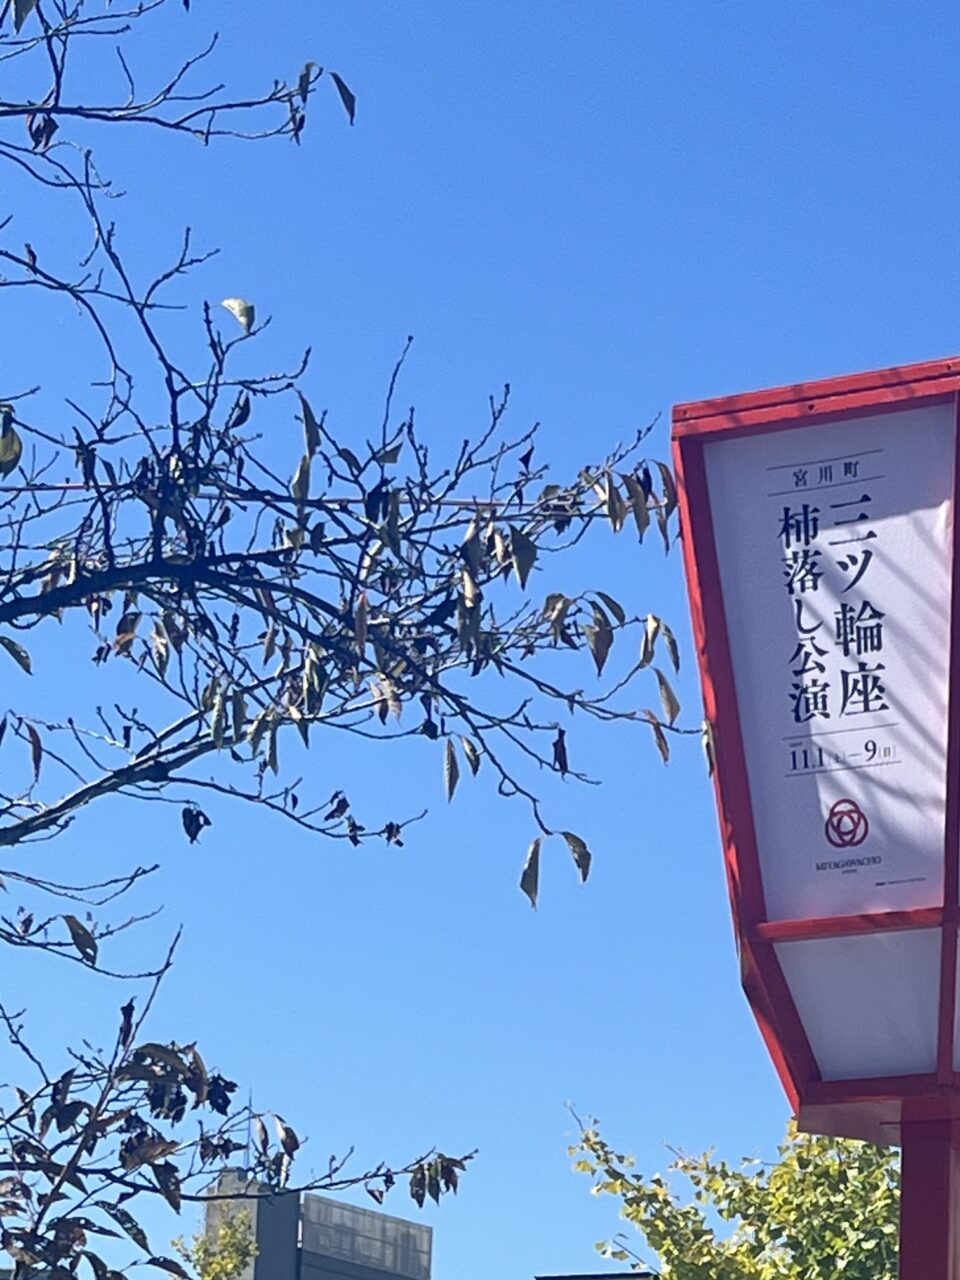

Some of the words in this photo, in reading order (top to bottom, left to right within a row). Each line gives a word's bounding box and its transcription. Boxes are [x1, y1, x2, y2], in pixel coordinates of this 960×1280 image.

[792, 460, 860, 488] 宮川町
[828, 493, 890, 719] 三ツ輪座
